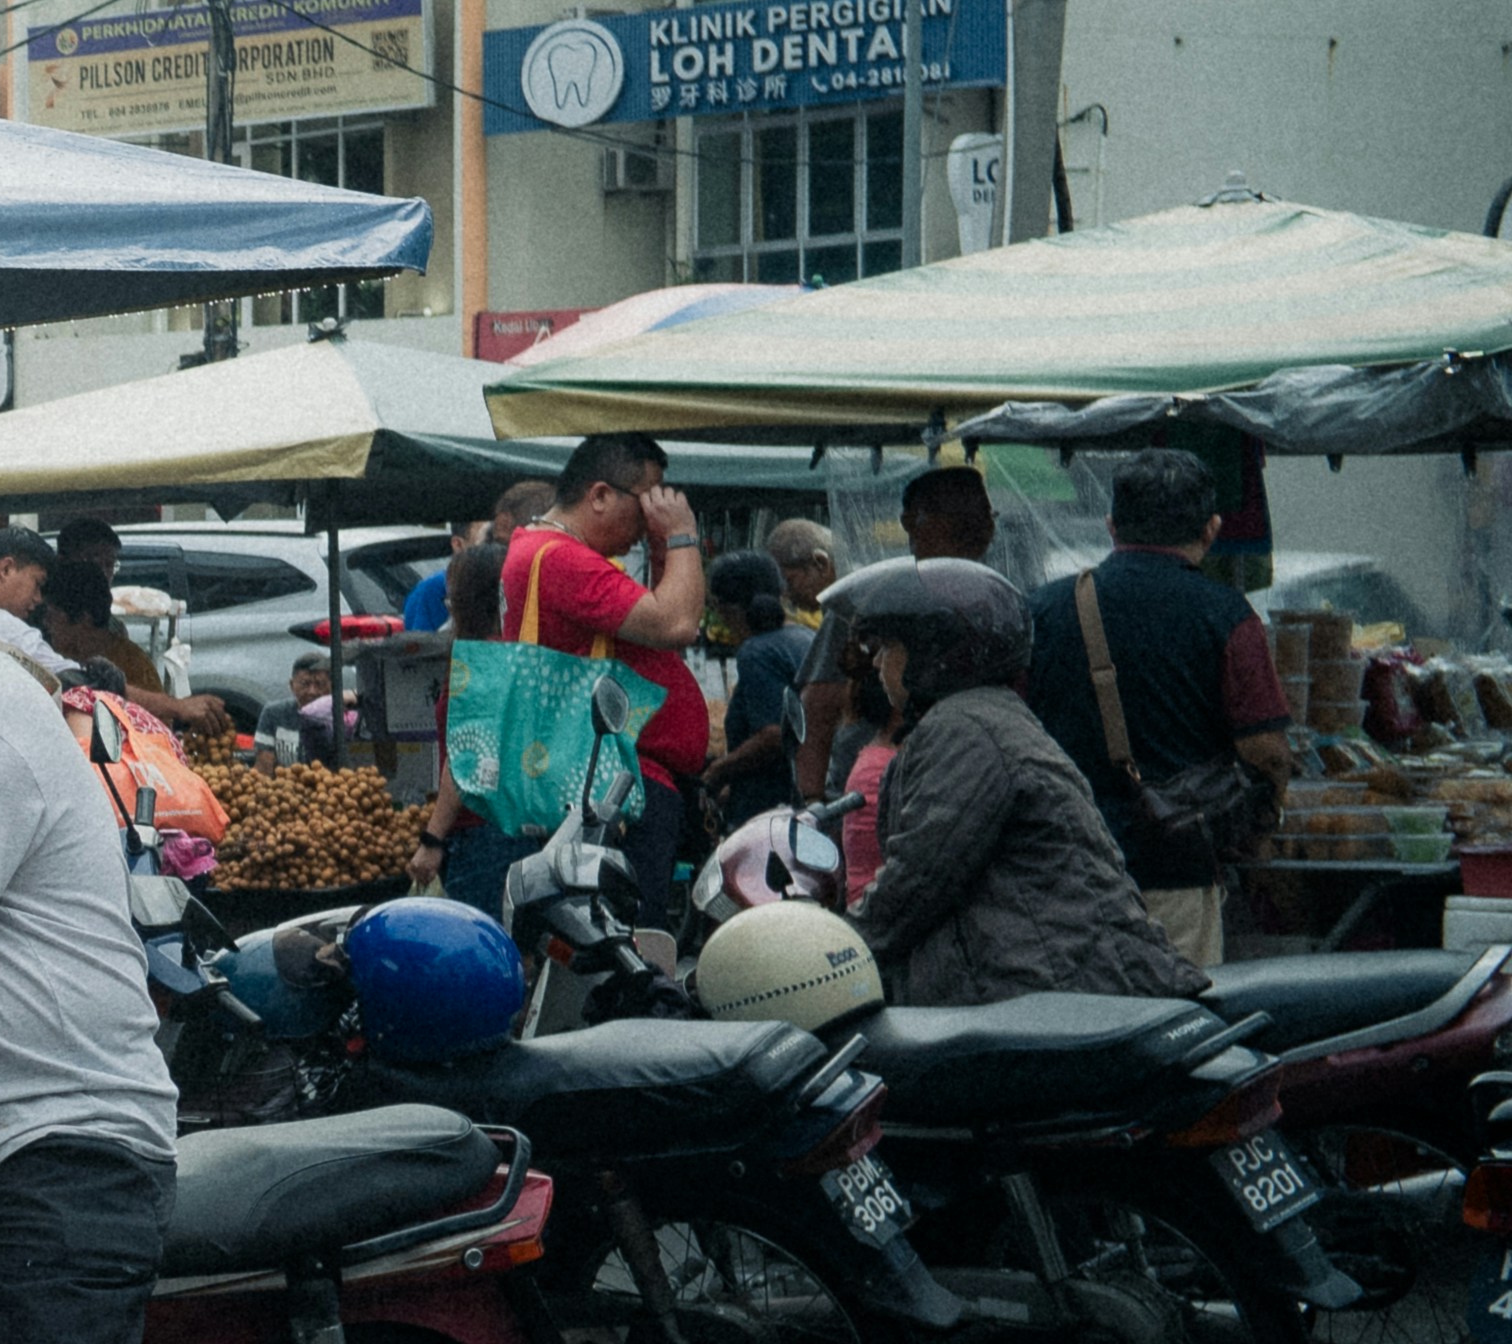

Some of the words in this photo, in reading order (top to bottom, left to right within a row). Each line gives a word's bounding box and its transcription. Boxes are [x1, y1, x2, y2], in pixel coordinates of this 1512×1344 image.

[650, 8, 757, 47] KLINIK
[79, 60, 147, 91] PILLSON
[152, 52, 210, 83] CREDIT
[233, 37, 335, 72] RPORATION
[650, 41, 735, 84] LOH
[836, 1153, 881, 1202] PBM
[1228, 1135, 1274, 1177] PJC
[853, 1178, 904, 1233] 3061
[1243, 1163, 1305, 1212] 8201
